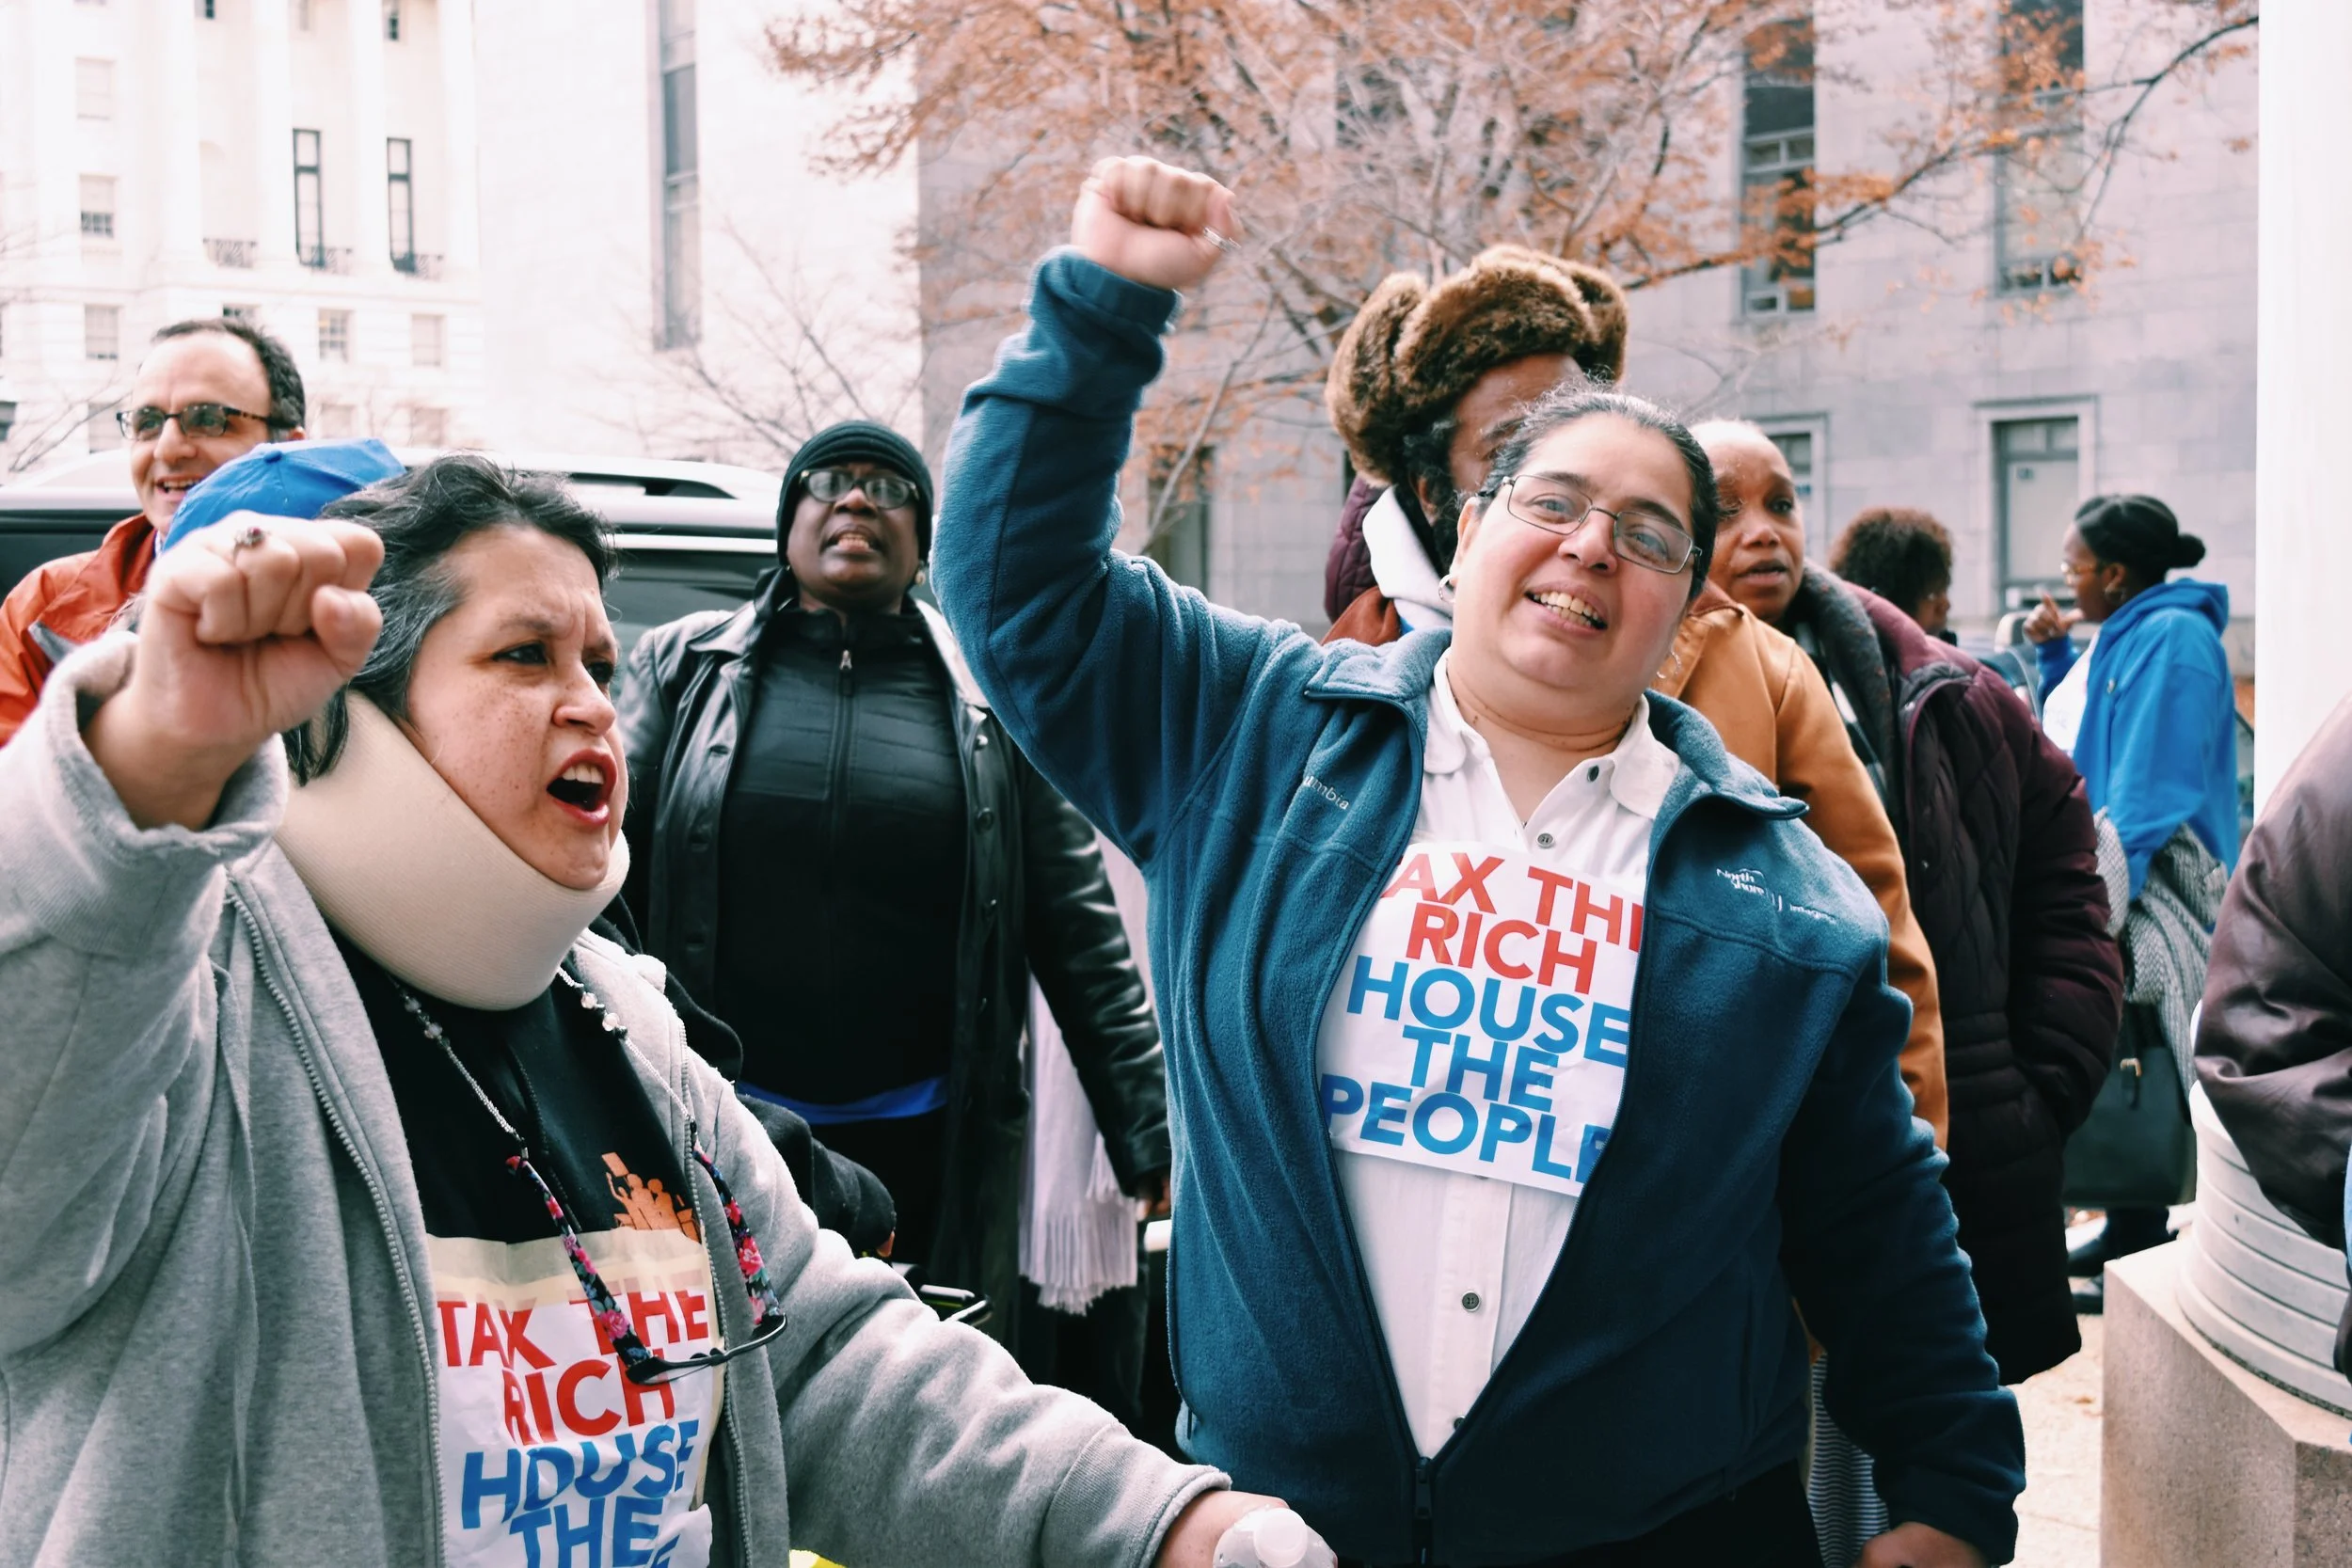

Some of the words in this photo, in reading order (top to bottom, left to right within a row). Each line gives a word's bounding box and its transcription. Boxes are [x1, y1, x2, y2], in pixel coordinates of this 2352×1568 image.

[1380, 852, 1505, 914] AX
[1406, 903, 1597, 995] RICH
[1346, 955, 1629, 1069] HOUSE
[1402, 1024, 1559, 1112] THE
[436, 1291, 557, 1369] TAX
[566, 1270, 709, 1355] THE
[502, 1349, 675, 1446] RICH
[509, 1496, 663, 1568] THE
